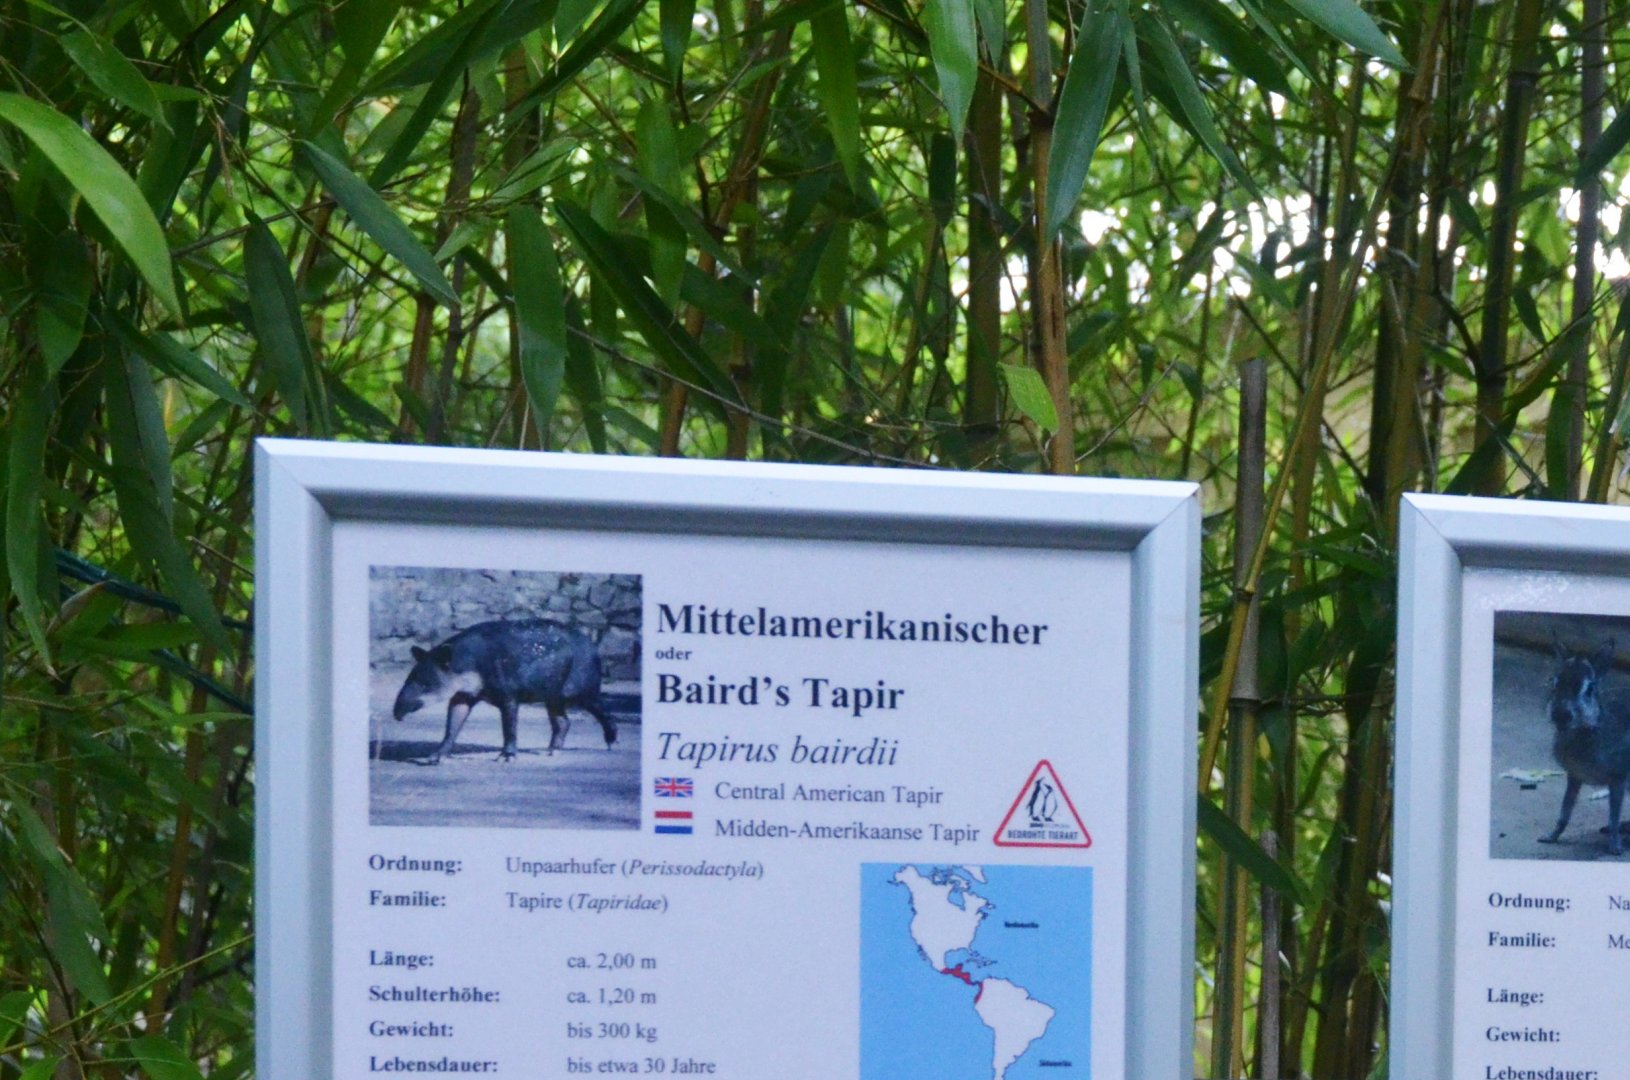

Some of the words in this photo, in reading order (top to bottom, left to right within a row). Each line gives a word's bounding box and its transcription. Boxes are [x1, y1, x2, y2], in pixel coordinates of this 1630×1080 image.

[658, 603, 1048, 646] Mittelamerikanischer
[655, 645, 692, 661] oder
[803, 677, 904, 718] Tapir
[659, 731, 779, 770] Tapirus
[790, 734, 898, 767] bairdii
[714, 781, 785, 801] Central
[792, 783, 885, 804] American
[892, 785, 944, 809] Tapir
[715, 818, 923, 842] Midden-Amerikaanse
[929, 823, 980, 846] Tapir
[368, 854, 462, 876] Ordnung:
[506, 856, 617, 878] Unpaarhufer
[621, 858, 764, 881] (Perissodactyla)
[370, 889, 446, 908] Familie:
[505, 892, 563, 914] Tapire
[567, 892, 669, 915] (Tapiridae)
[1488, 892, 1570, 913] Ordnung:
[1488, 931, 1555, 948] Familie:
[370, 949, 433, 971] Länge:
[566, 956, 591, 969] ca.
[597, 951, 635, 971] 2,00
[640, 956, 657, 970] m
[369, 985, 499, 1003] Schulterhöhe:
[566, 991, 591, 1005] ca.
[599, 987, 635, 1007] 1,20
[640, 991, 657, 1005] m
[1487, 987, 1543, 1008] Länge:
[369, 1020, 453, 1038] Gewicht:
[567, 1021, 593, 1040] bis
[598, 1022, 631, 1039] 300
[635, 1022, 658, 1044] kg
[1486, 1026, 1560, 1042] Gewicht:
[370, 1056, 497, 1073] Lebensdauer:
[567, 1056, 593, 1074] bis
[597, 1059, 639, 1075] etwa
[644, 1057, 666, 1075] 30
[670, 1057, 716, 1075] Jahre
